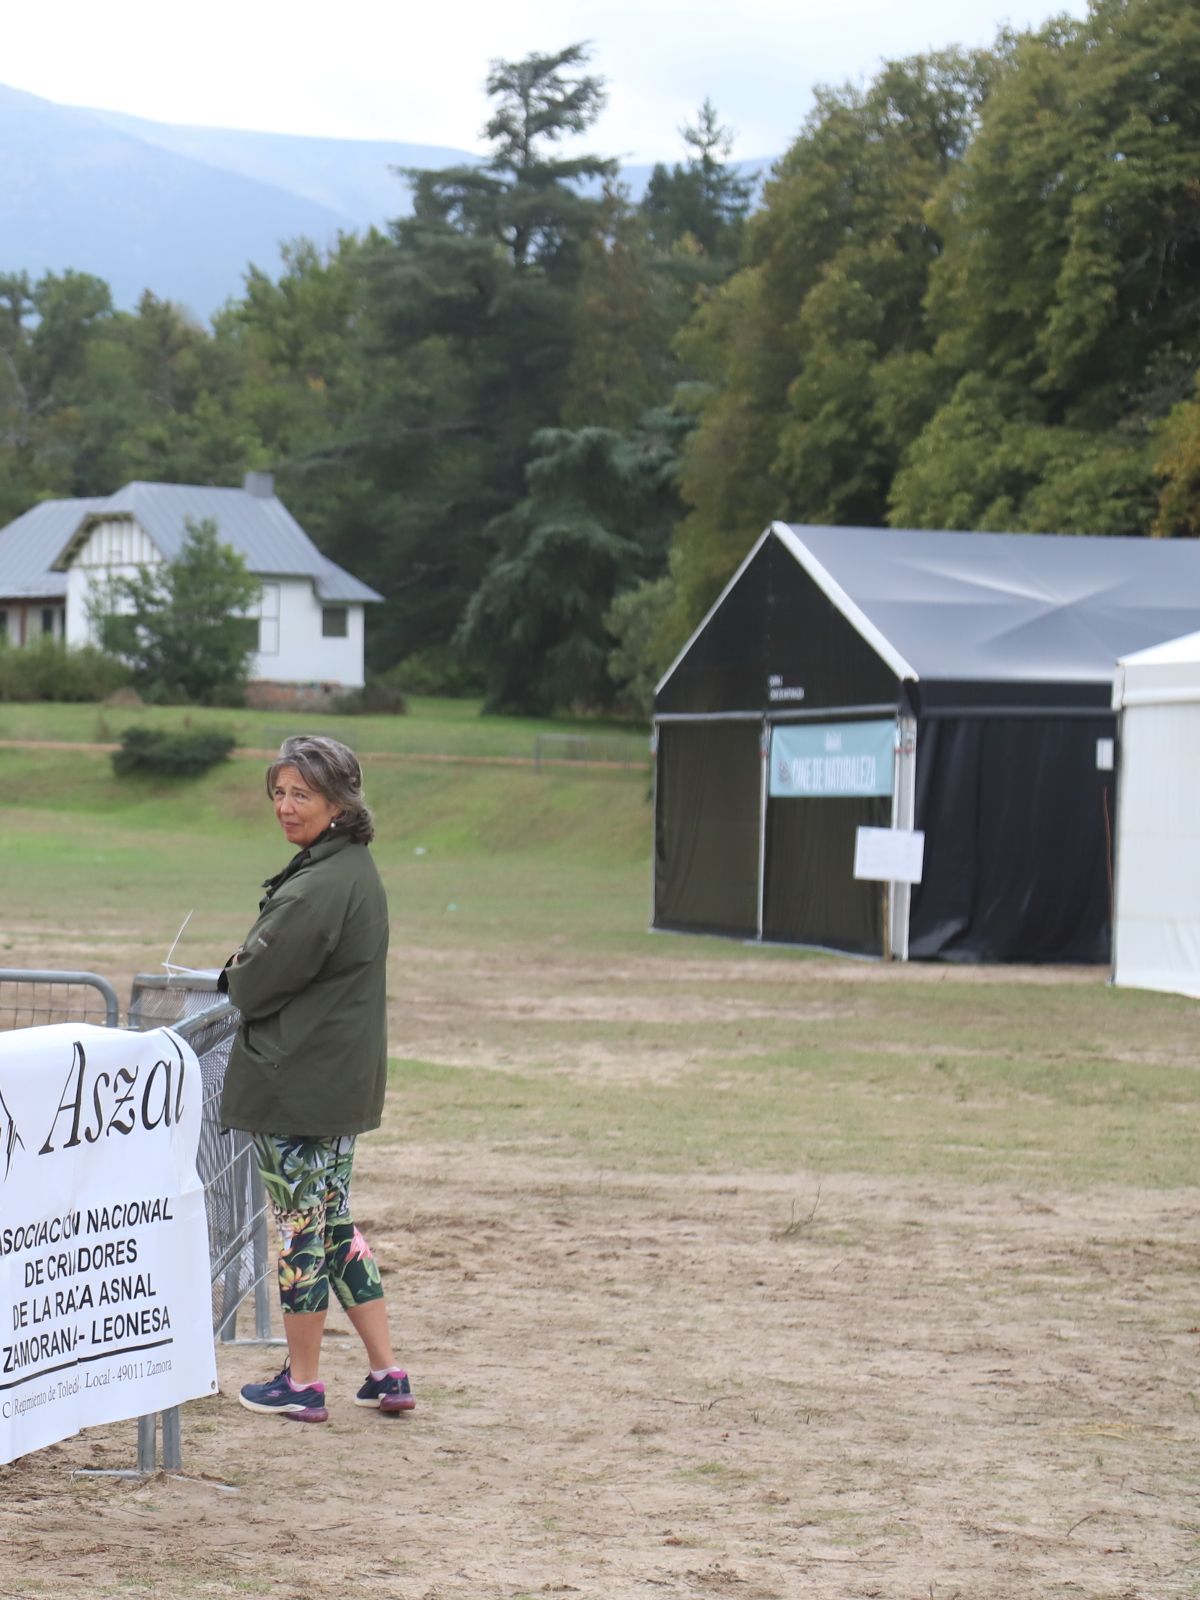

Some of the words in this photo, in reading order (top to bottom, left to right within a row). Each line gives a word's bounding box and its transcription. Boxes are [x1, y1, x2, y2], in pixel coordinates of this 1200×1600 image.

[38, 1027, 185, 1156] Aszal
[86, 1197, 174, 1234] NACIONAL
[24, 1259, 44, 1288] DE
[12, 1301, 28, 1331] DE
[33, 1295, 52, 1324] LA
[55, 1284, 94, 1317] RAA
[98, 1272, 157, 1306] ASNAL
[91, 1305, 171, 1344] LEONESA
[47, 1385, 56, 1402] de
[85, 1368, 111, 1388] Local
[117, 1361, 144, 1382] 49011
[146, 1359, 172, 1377] Zamora
